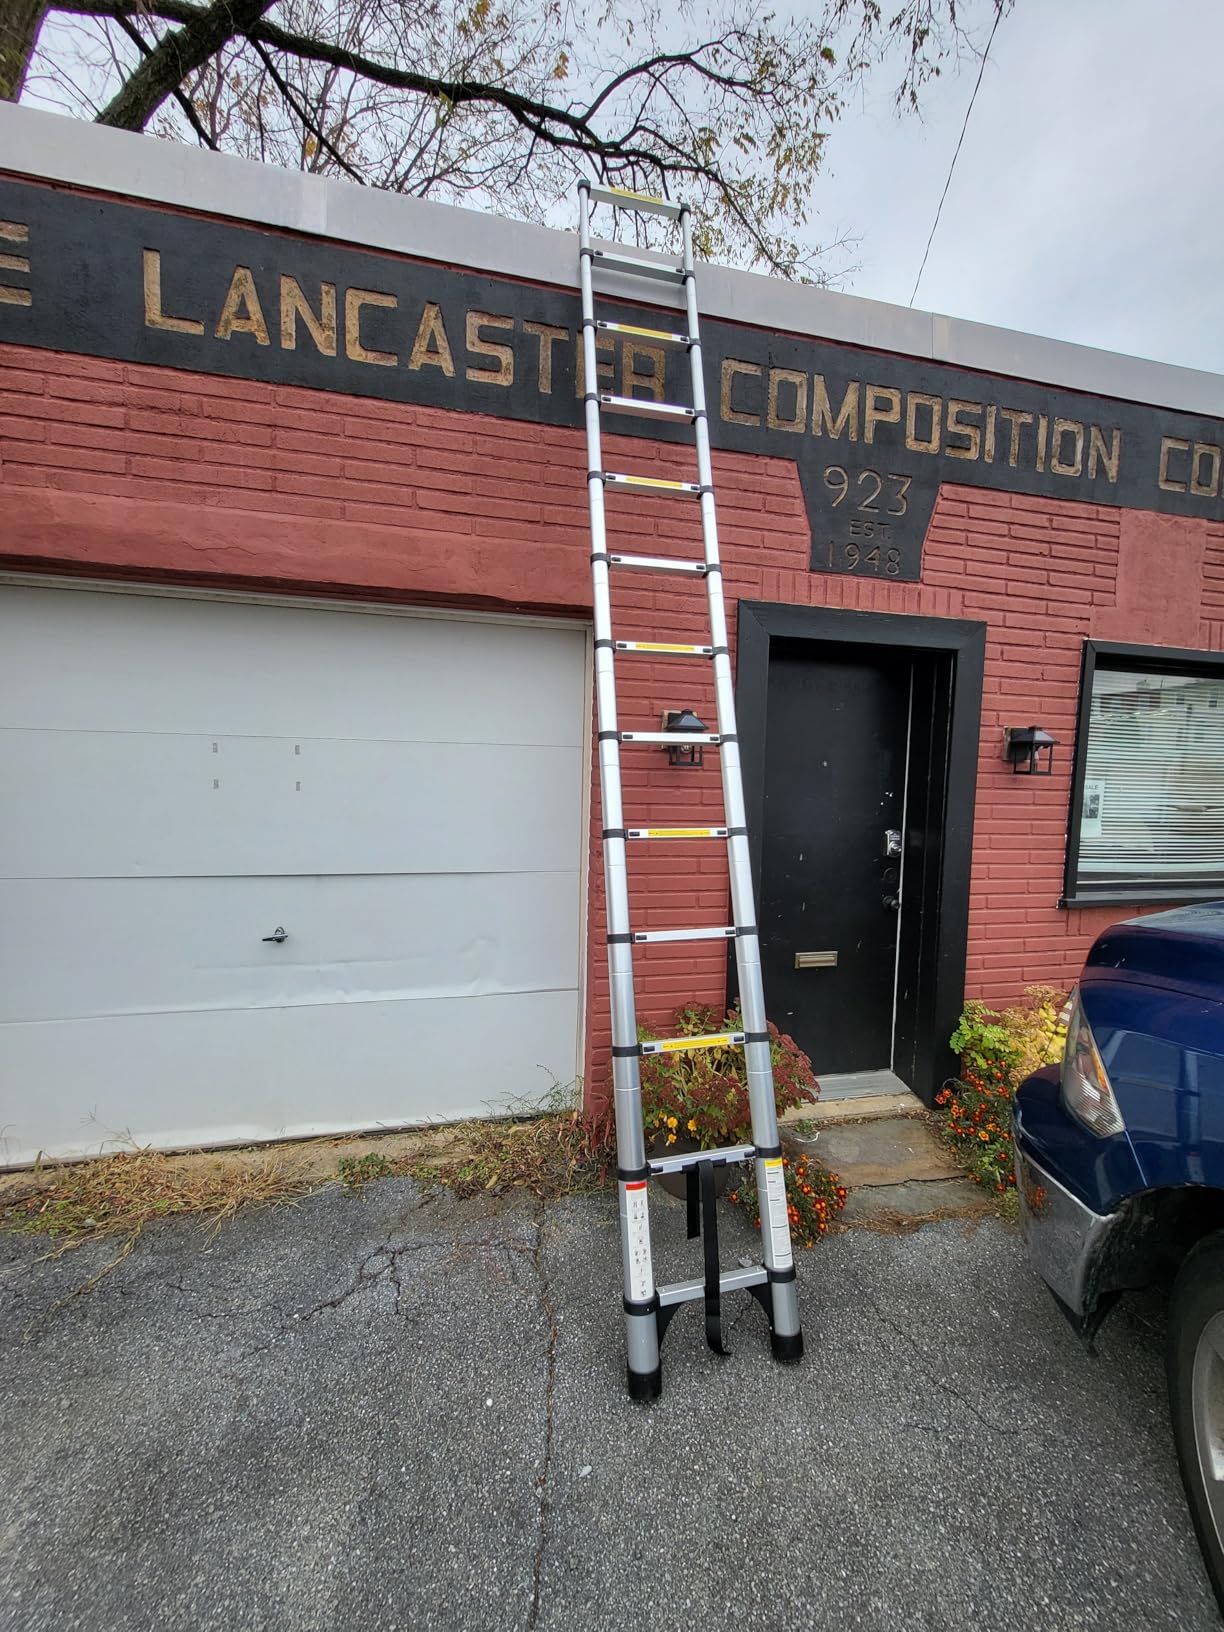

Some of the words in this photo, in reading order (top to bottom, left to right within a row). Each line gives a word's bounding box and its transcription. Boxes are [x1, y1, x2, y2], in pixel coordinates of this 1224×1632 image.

[143, 247, 665, 404] LANCASTER
[719, 357, 1121, 483] COMPOSITION
[1159, 436, 1224, 499] CO
[823, 465, 912, 516] 923
[828, 541, 900, 575] 1948
